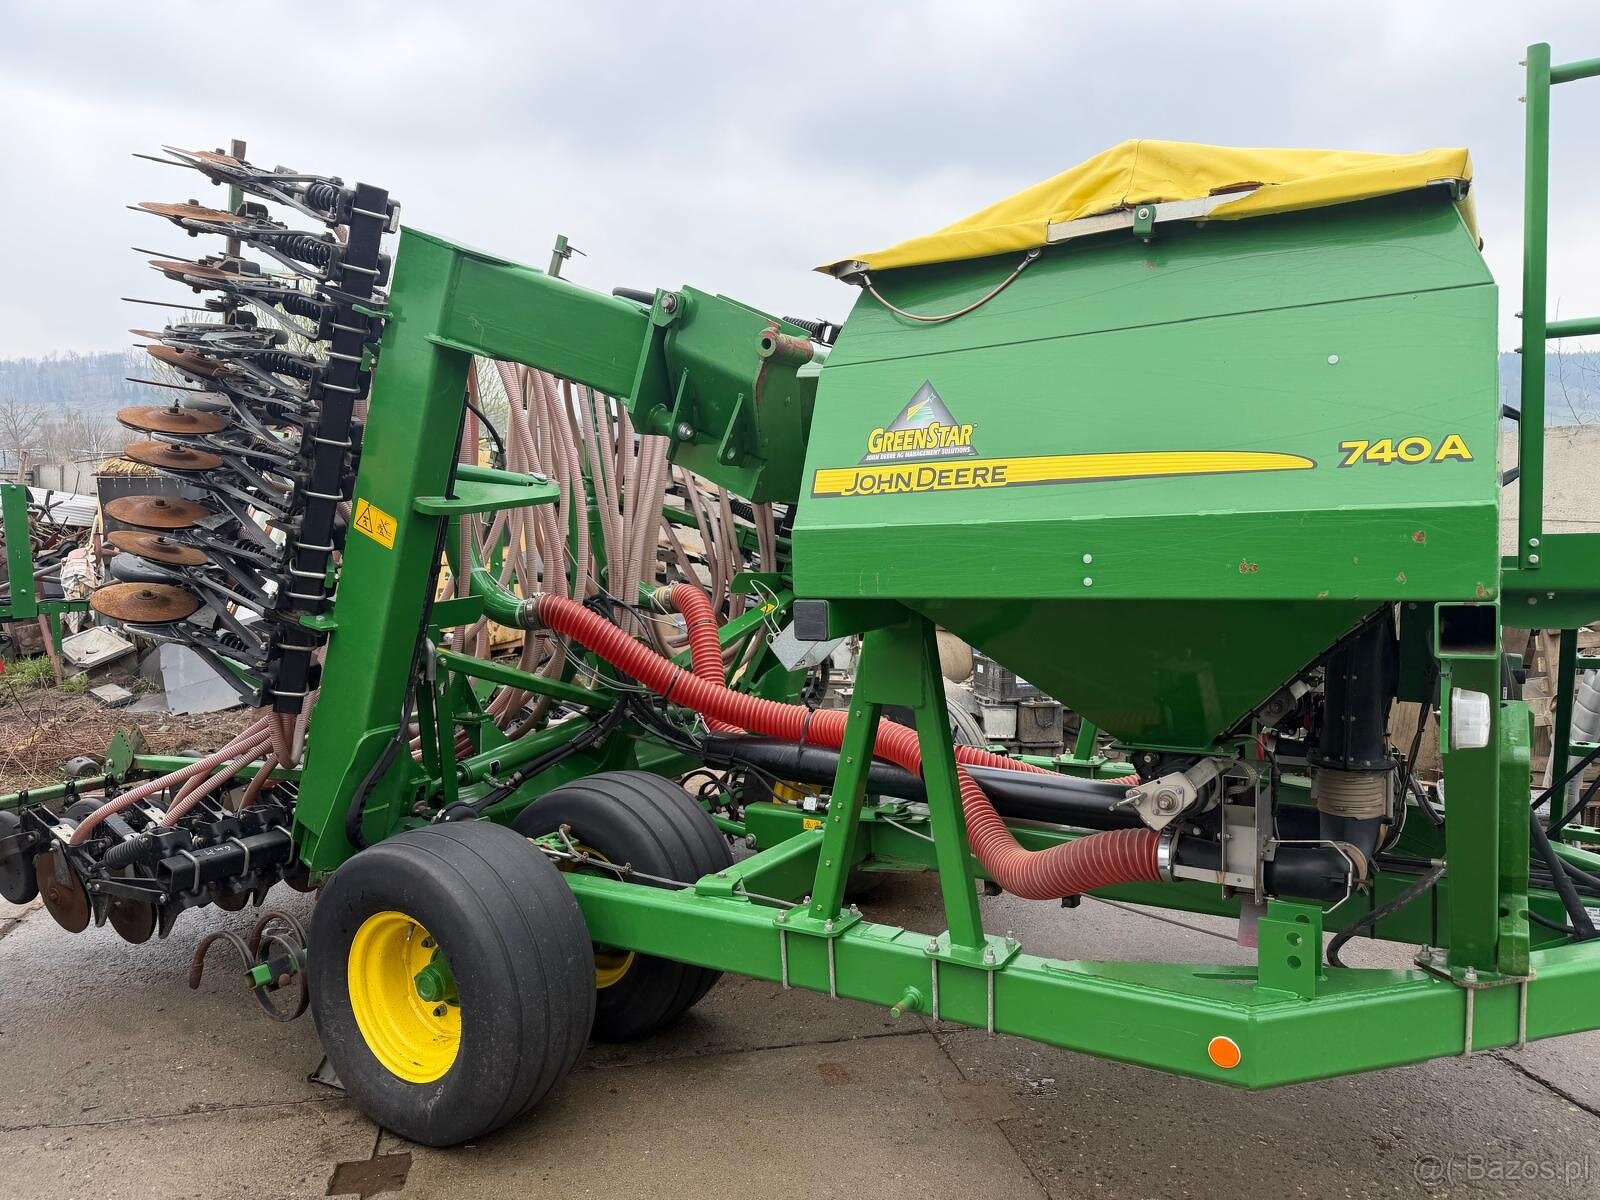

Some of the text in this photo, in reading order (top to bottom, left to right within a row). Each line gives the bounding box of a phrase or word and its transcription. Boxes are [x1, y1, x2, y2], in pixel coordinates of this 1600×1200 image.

[880, 452, 896, 460] DEERE
[905, 449, 941, 457] MANAGEMENT
[1338, 434, 1473, 468] 740A
[845, 465, 1008, 493] JOHN DEERE
